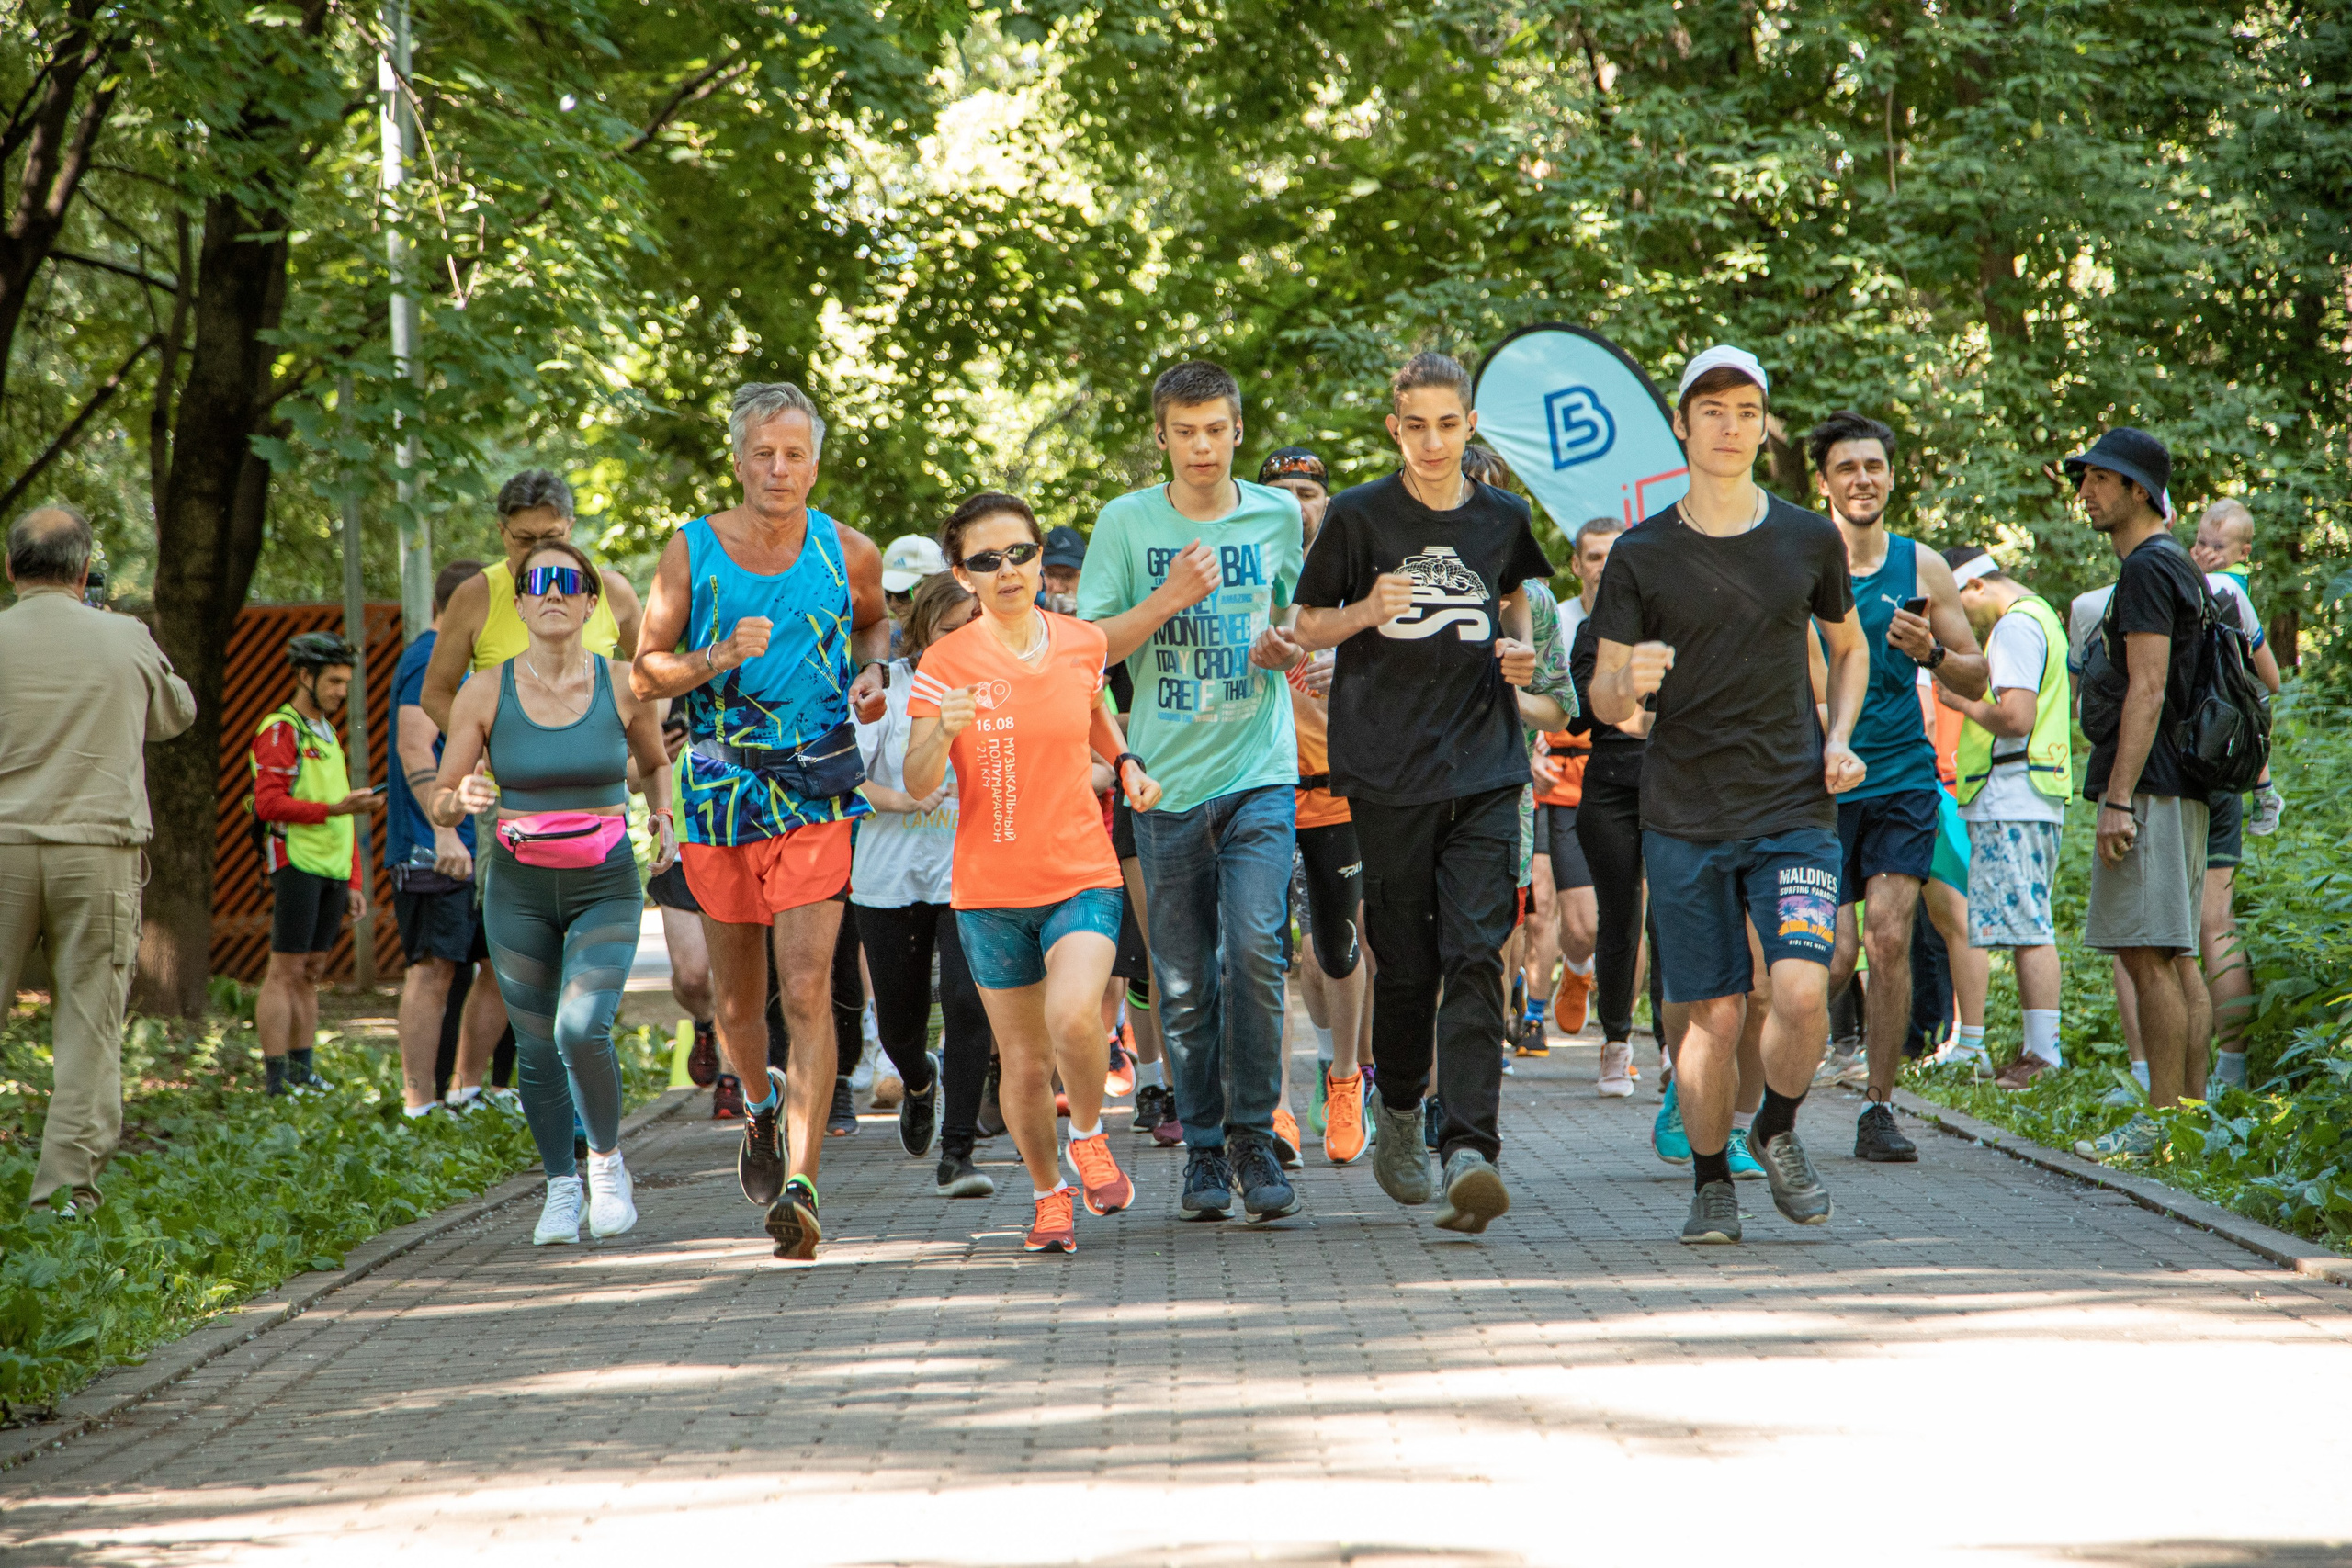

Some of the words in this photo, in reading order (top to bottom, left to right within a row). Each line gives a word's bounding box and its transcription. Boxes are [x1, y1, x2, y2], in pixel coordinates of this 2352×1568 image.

[1156, 649, 1190, 675] ITALY
[1158, 677, 1216, 711] CRETE
[976, 716, 1014, 732] 16.08
[988, 739, 1002, 843] ПОЛУМАРАФОН
[1002, 737, 1017, 842] МУЗЫКАЛЬНЫЙ
[1780, 867, 1838, 893] MALDIVES
[1780, 885, 1810, 897] SURFING
[1811, 886, 1838, 905] PARADISE
